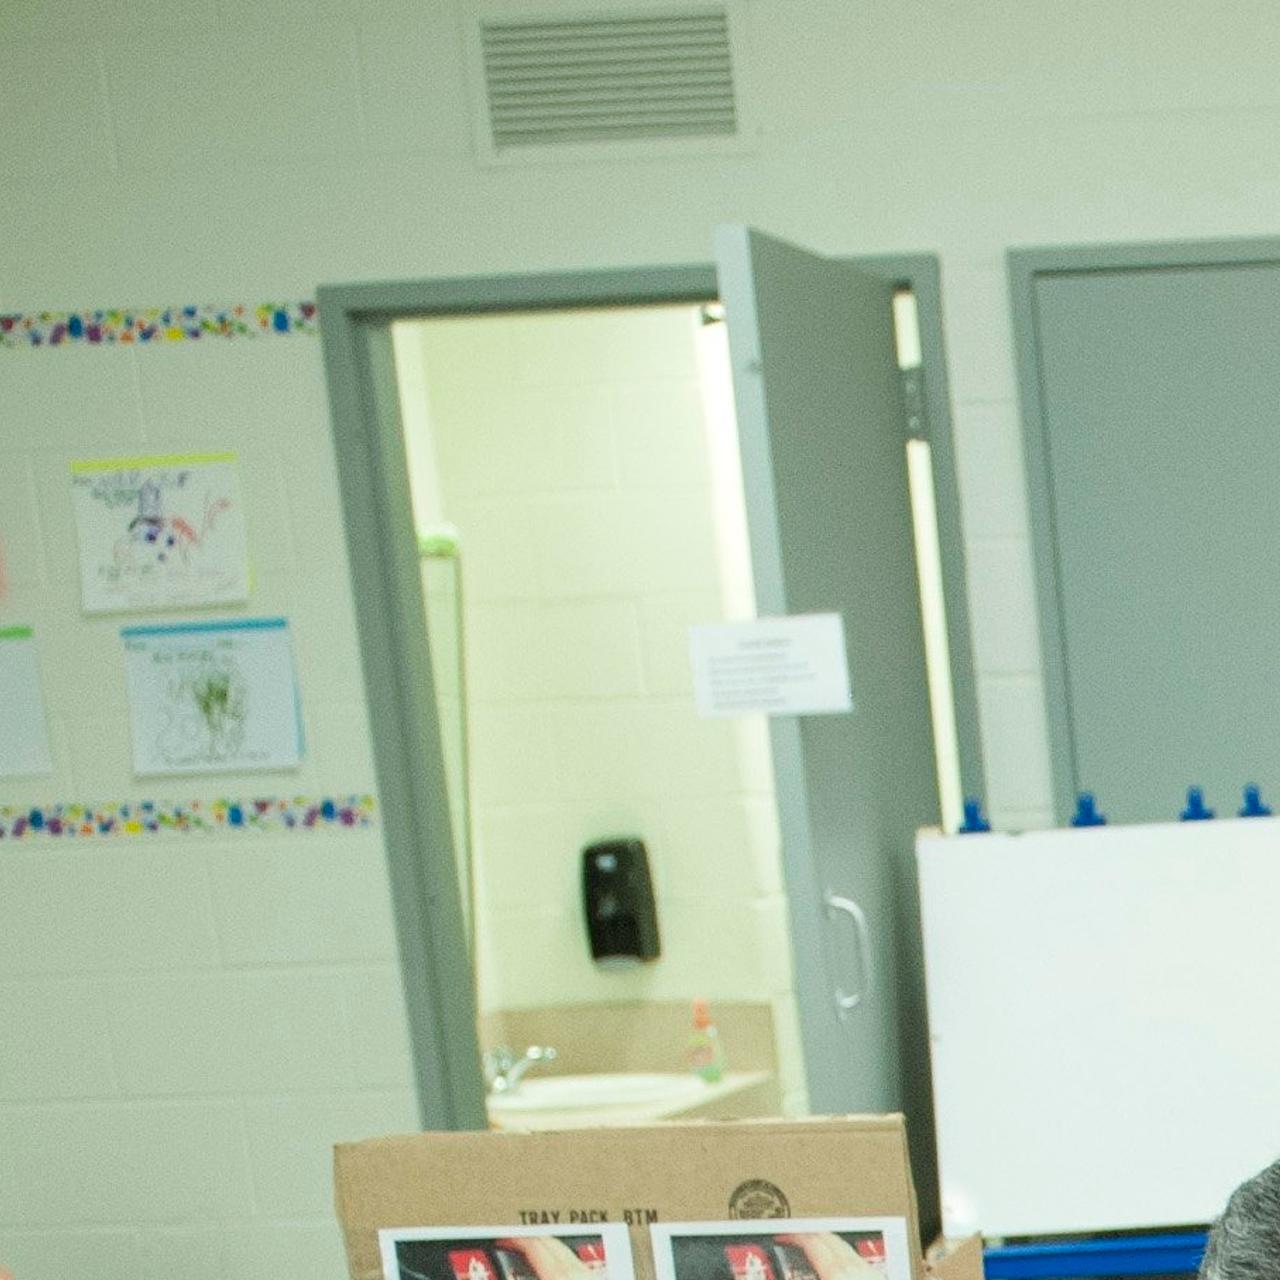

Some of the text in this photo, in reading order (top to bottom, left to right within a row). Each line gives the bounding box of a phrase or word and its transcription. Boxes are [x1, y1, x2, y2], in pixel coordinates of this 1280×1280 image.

[518, 1208, 658, 1226] TRAY PACK BTM
